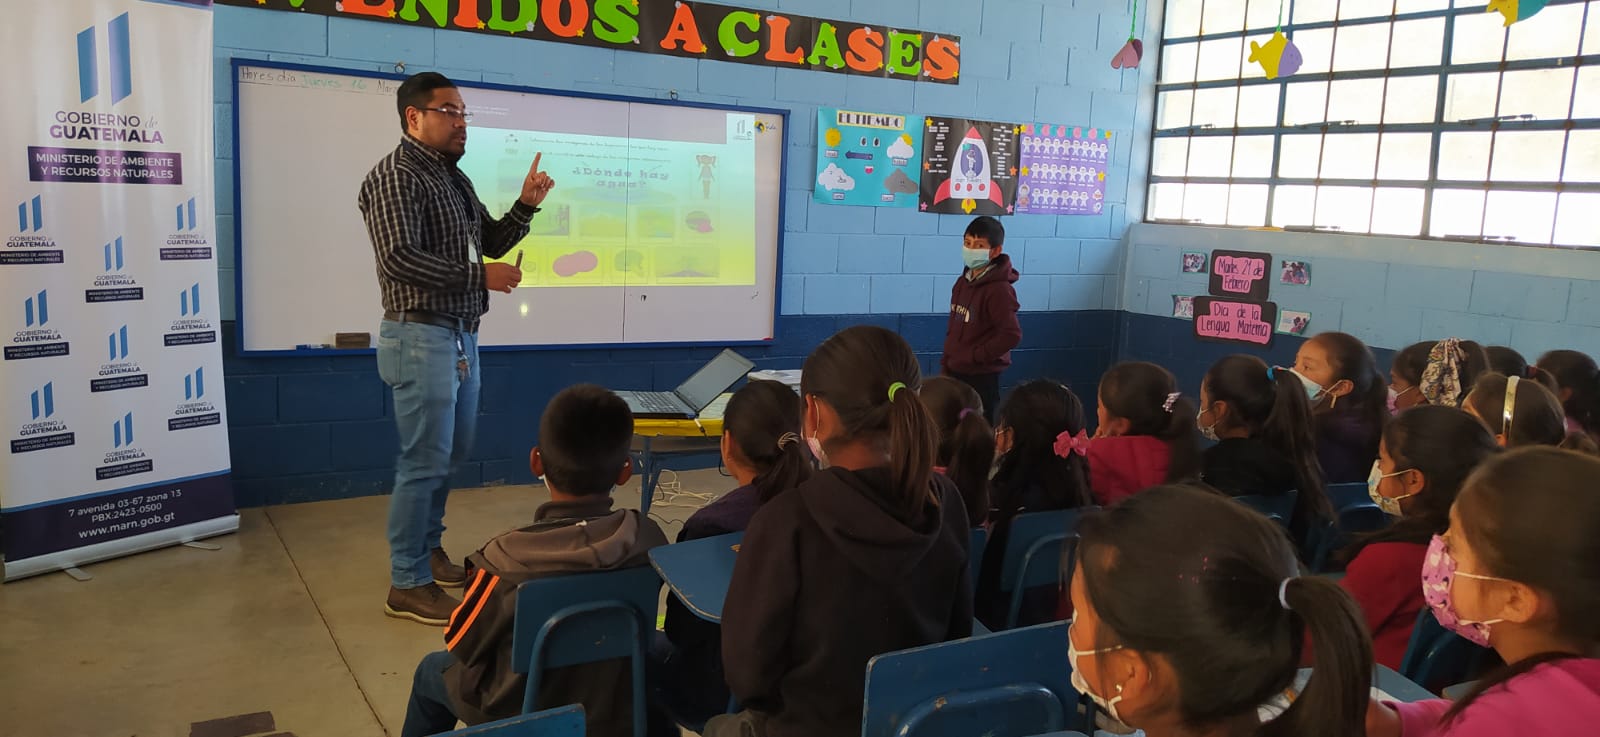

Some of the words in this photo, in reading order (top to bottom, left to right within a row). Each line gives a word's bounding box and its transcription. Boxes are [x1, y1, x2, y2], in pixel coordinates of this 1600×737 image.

[289, 0, 640, 43] NIDOS
[659, 2, 704, 53] A
[717, 11, 960, 80] CLASES
[55, 111, 141, 127] GOBIERNO
[145, 116, 158, 129] de
[50, 125, 164, 144] GUATEMALA
[36, 153, 101, 165] MINISTERIO
[104, 157, 118, 165] DE
[119, 157, 174, 167] AMBIENTE
[41, 166, 48, 175] Y
[51, 167, 111, 177] RECURSOS
[113, 168, 174, 179] NATURALES
[1242, 260, 1252, 275] 21
[1253, 260, 1263, 276] de
[1224, 275, 1249, 291] Febrero
[1237, 304, 1246, 318] de
[1252, 306, 1259, 320] la
[171, 323, 211, 331] GUATEMALA
[1201, 316, 1230, 336] Lengua
[13, 334, 61, 342] GUATEMALA
[98, 366, 141, 376] GUATEMALA
[175, 405, 215, 415] GUATEMALA
[20, 425, 67, 436] GUATEMALA
[103, 452, 146, 463] GUATEMALA
[68, 509, 75, 517] 7
[77, 503, 115, 516] avenida
[118, 496, 144, 509] 03-67
[146, 493, 168, 503] zona
[171, 489, 182, 498] 13
[91, 503, 162, 523] PBX:2423-0500
[79, 512, 176, 539] www.marn.gob.gt
